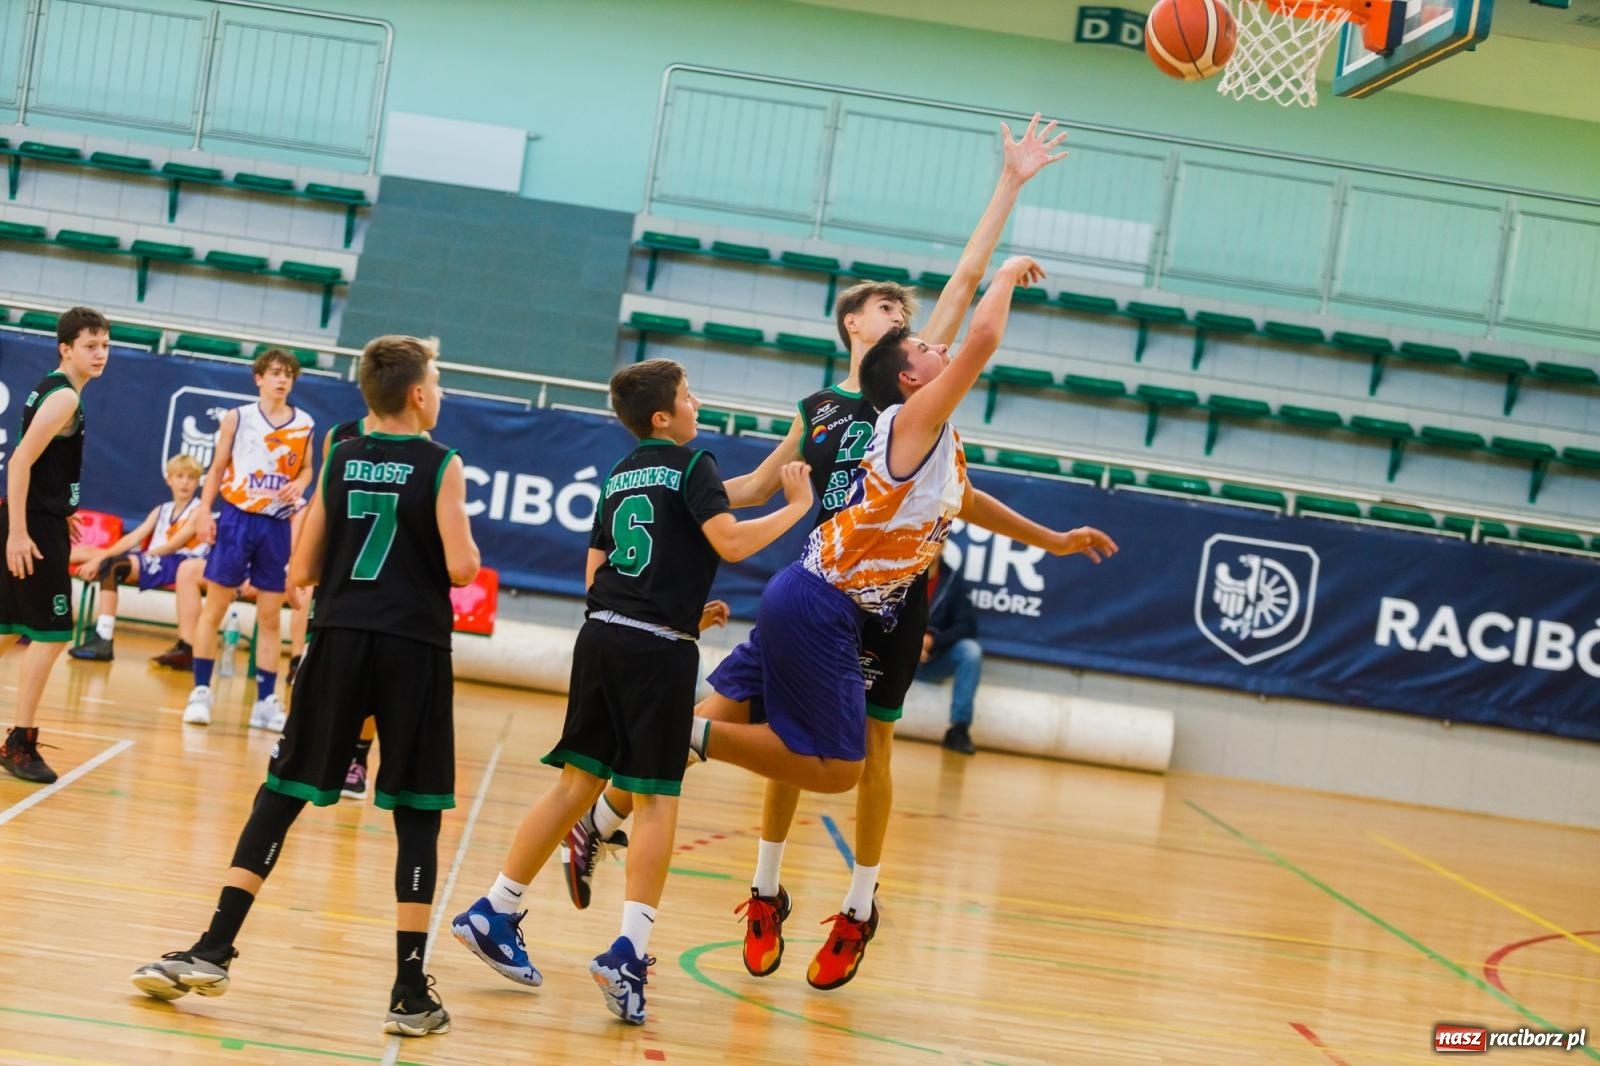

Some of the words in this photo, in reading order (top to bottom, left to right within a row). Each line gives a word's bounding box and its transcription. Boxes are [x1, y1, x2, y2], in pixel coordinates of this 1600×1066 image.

[1082, 18, 1110, 39] D
[1120, 23, 1143, 45] D
[827, 413, 853, 431] OPOLE
[343, 460, 415, 485] DROST
[347, 489, 400, 581] 7
[608, 494, 655, 577] 6
[967, 587, 1043, 617] IBÓRZ
